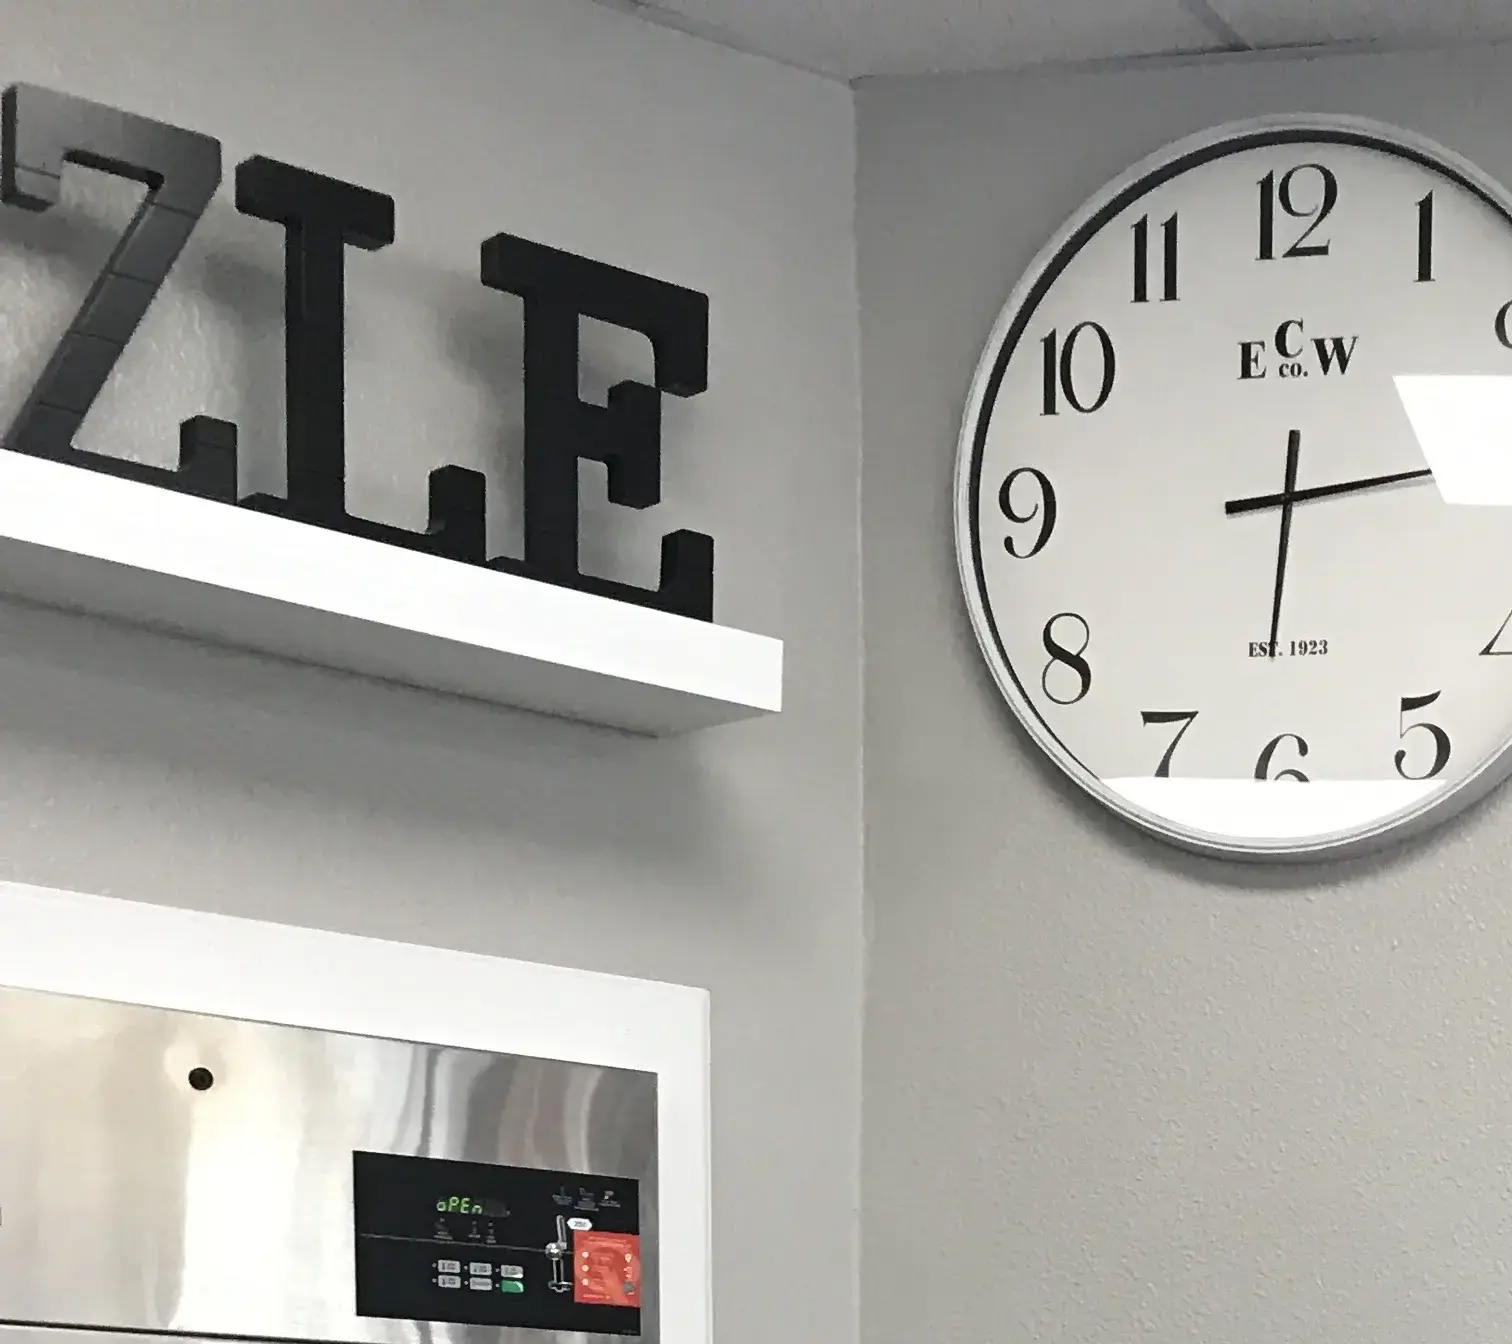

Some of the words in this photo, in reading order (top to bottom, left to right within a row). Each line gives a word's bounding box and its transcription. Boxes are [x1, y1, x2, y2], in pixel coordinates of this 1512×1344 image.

[1130, 210, 1181, 304] 11
[1255, 163, 1338, 261] 12
[1413, 190, 1437, 283] 1
[1039, 320, 1116, 417] 10
[998, 466, 1057, 559] 9
[1041, 612, 1093, 705] 8
[1289, 639, 1328, 656] 1923
[1140, 710, 1200, 778] 7
[1394, 689, 1453, 780] 5
